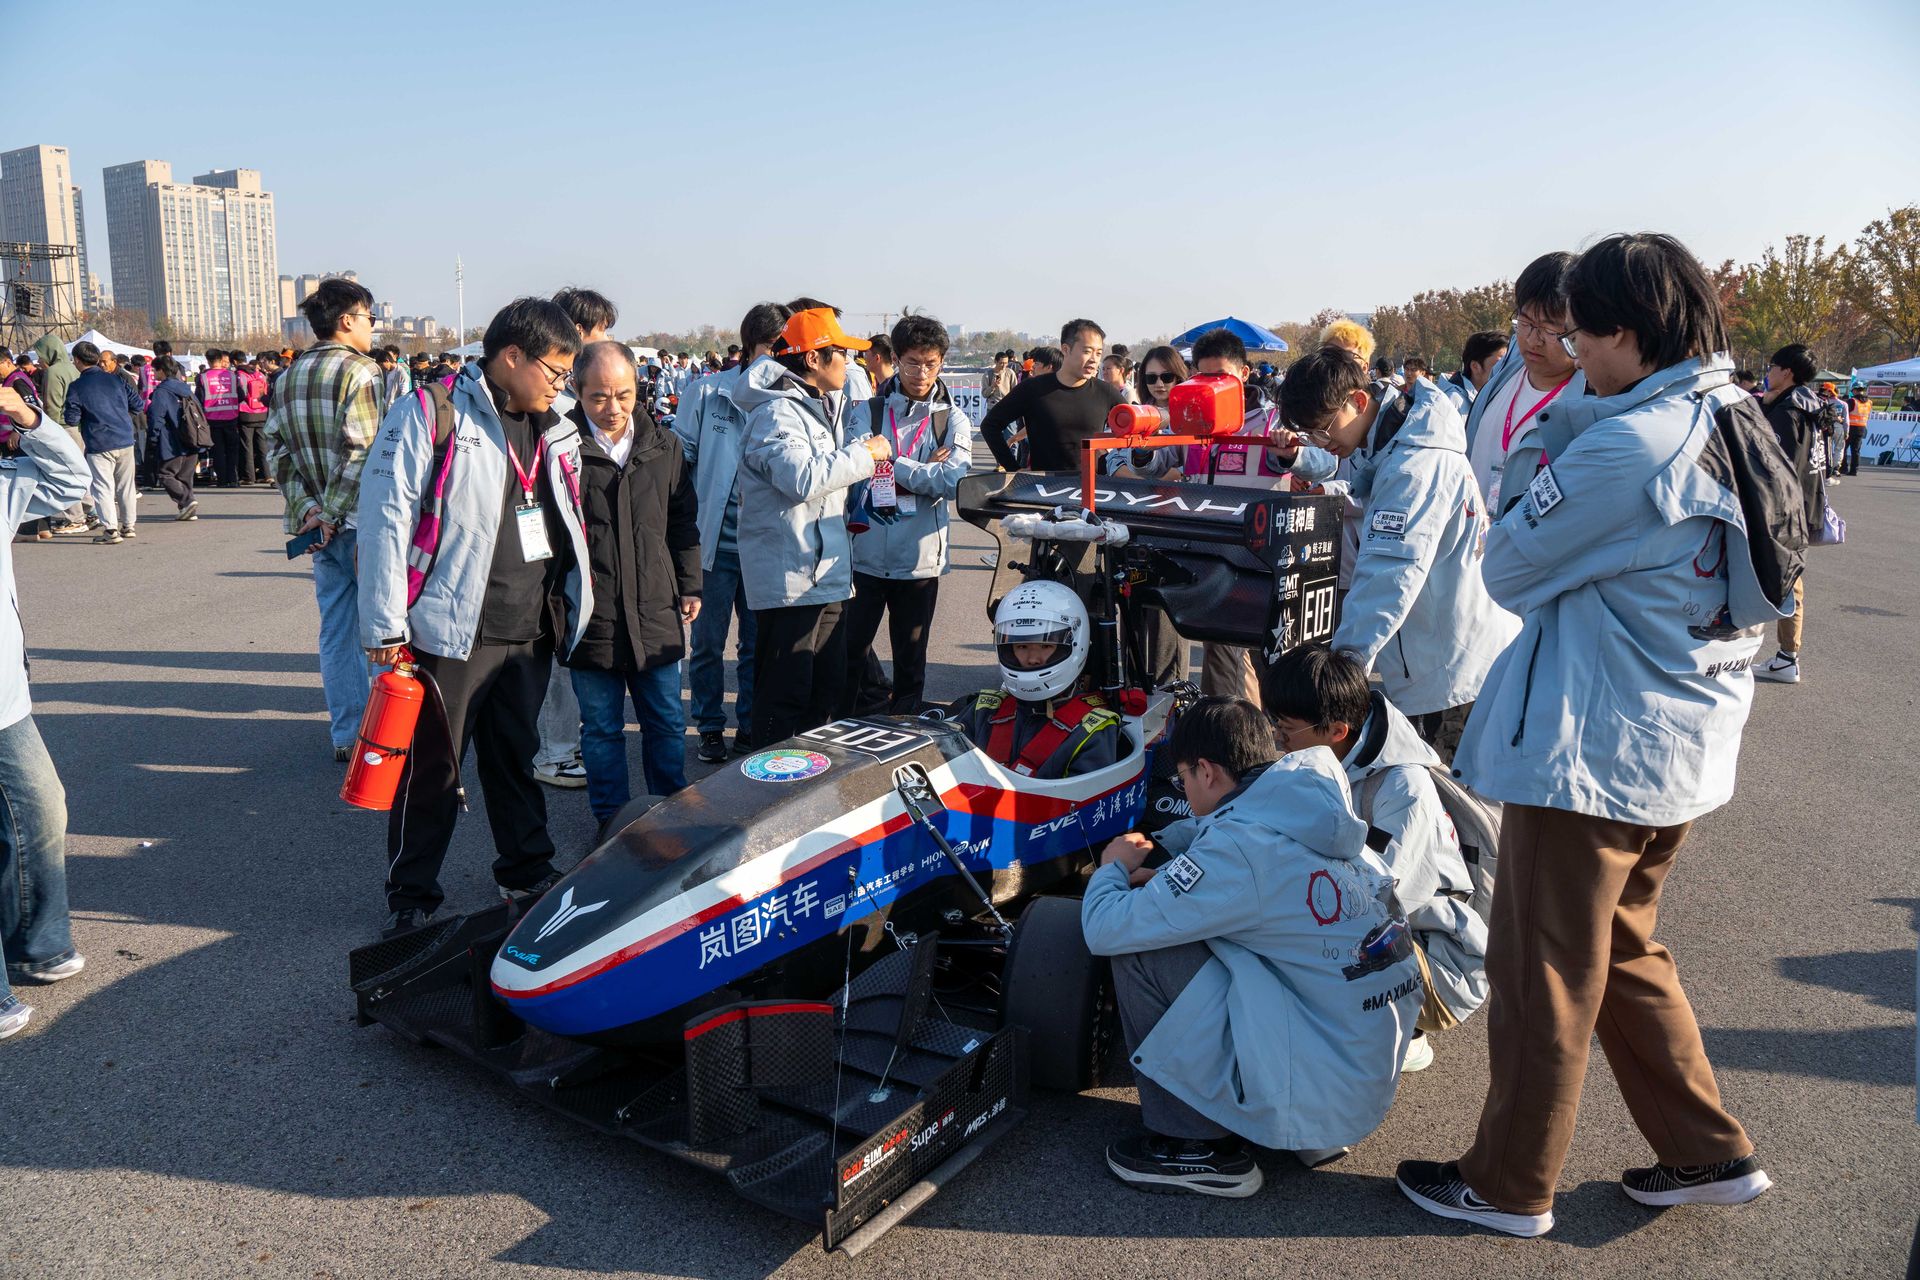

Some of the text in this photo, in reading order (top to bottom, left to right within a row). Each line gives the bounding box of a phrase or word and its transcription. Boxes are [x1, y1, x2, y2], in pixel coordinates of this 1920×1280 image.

[1867, 433, 1890, 447] NIO
[1035, 484, 1249, 516] VOYAH
[1275, 506, 1316, 535] 中复神鹰
[1279, 573, 1300, 593] SMT
[1016, 618, 1035, 627] OMP
[1303, 586, 1334, 641] E03
[800, 720, 918, 752] E03
[1029, 811, 1080, 841] EVE
[827, 902, 844, 915] SAE
[699, 880, 820, 970] 岚图汽车
